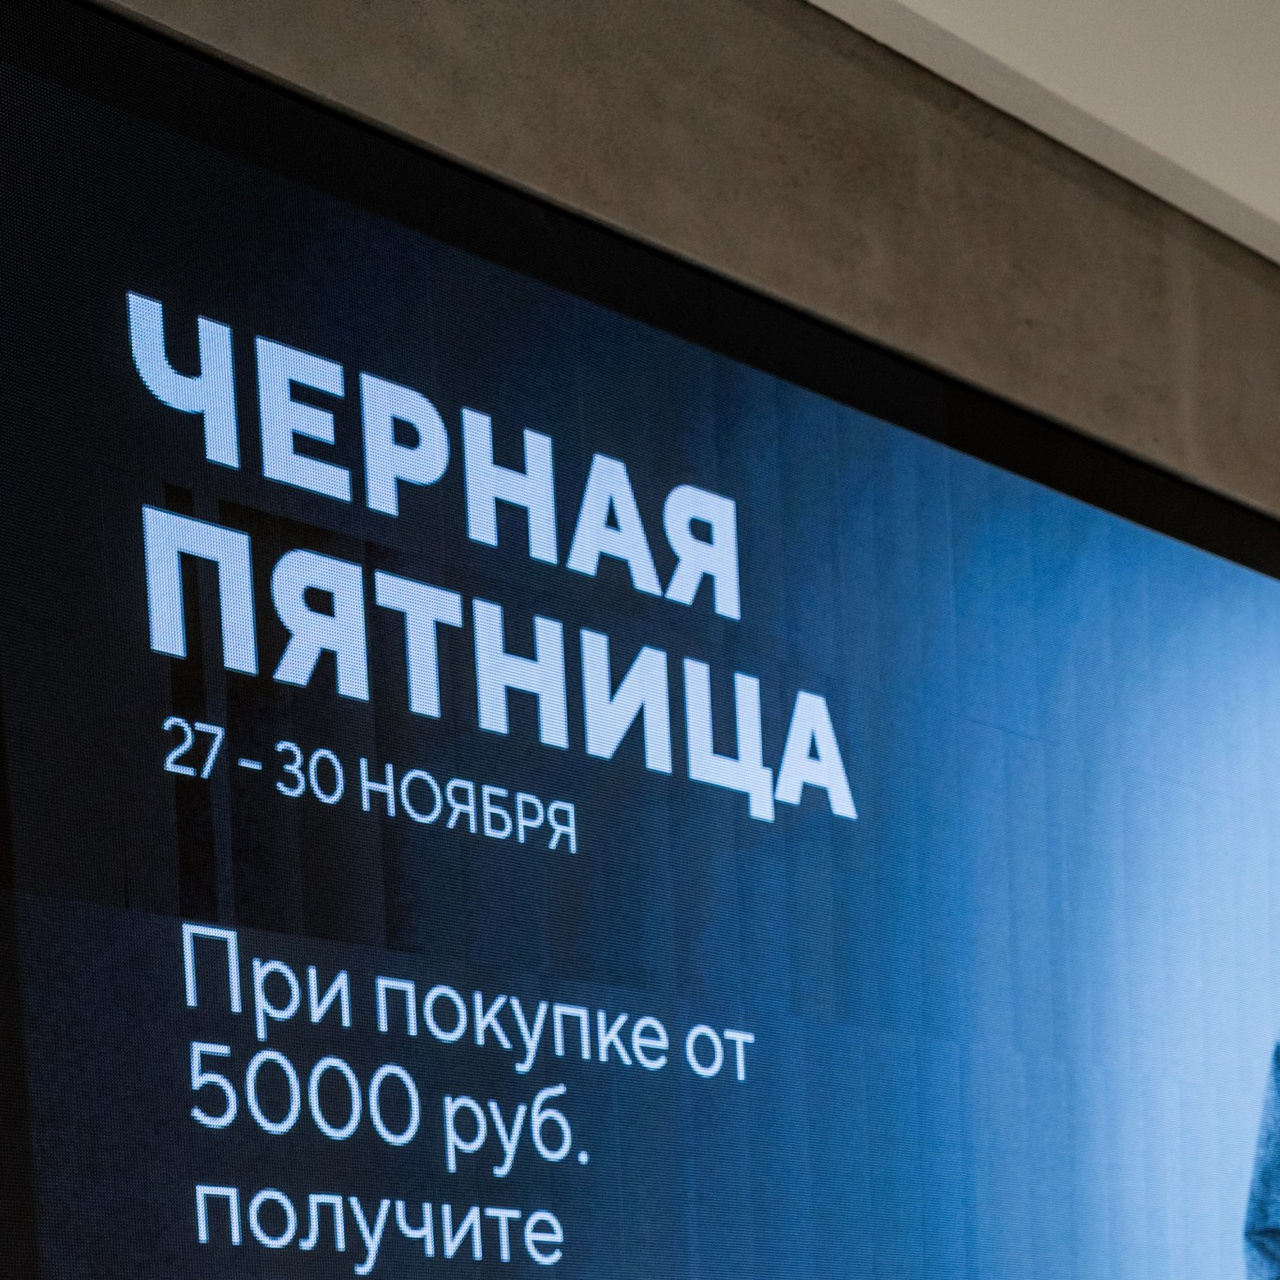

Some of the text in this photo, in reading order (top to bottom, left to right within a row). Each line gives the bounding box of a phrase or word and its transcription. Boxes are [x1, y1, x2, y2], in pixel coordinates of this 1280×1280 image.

[127, 291, 741, 620] ЧЕРНАЯ
[142, 505, 858, 822] ПЯТНИЦА
[163, 716, 226, 779] 27
[274, 740, 345, 805] 30
[360, 757, 579, 854] НОЯБРЯ
[182, 922, 756, 1082] При покупке от
[190, 1041, 589, 1178] 5000 руб.
[195, 1184, 565, 1276] получите
